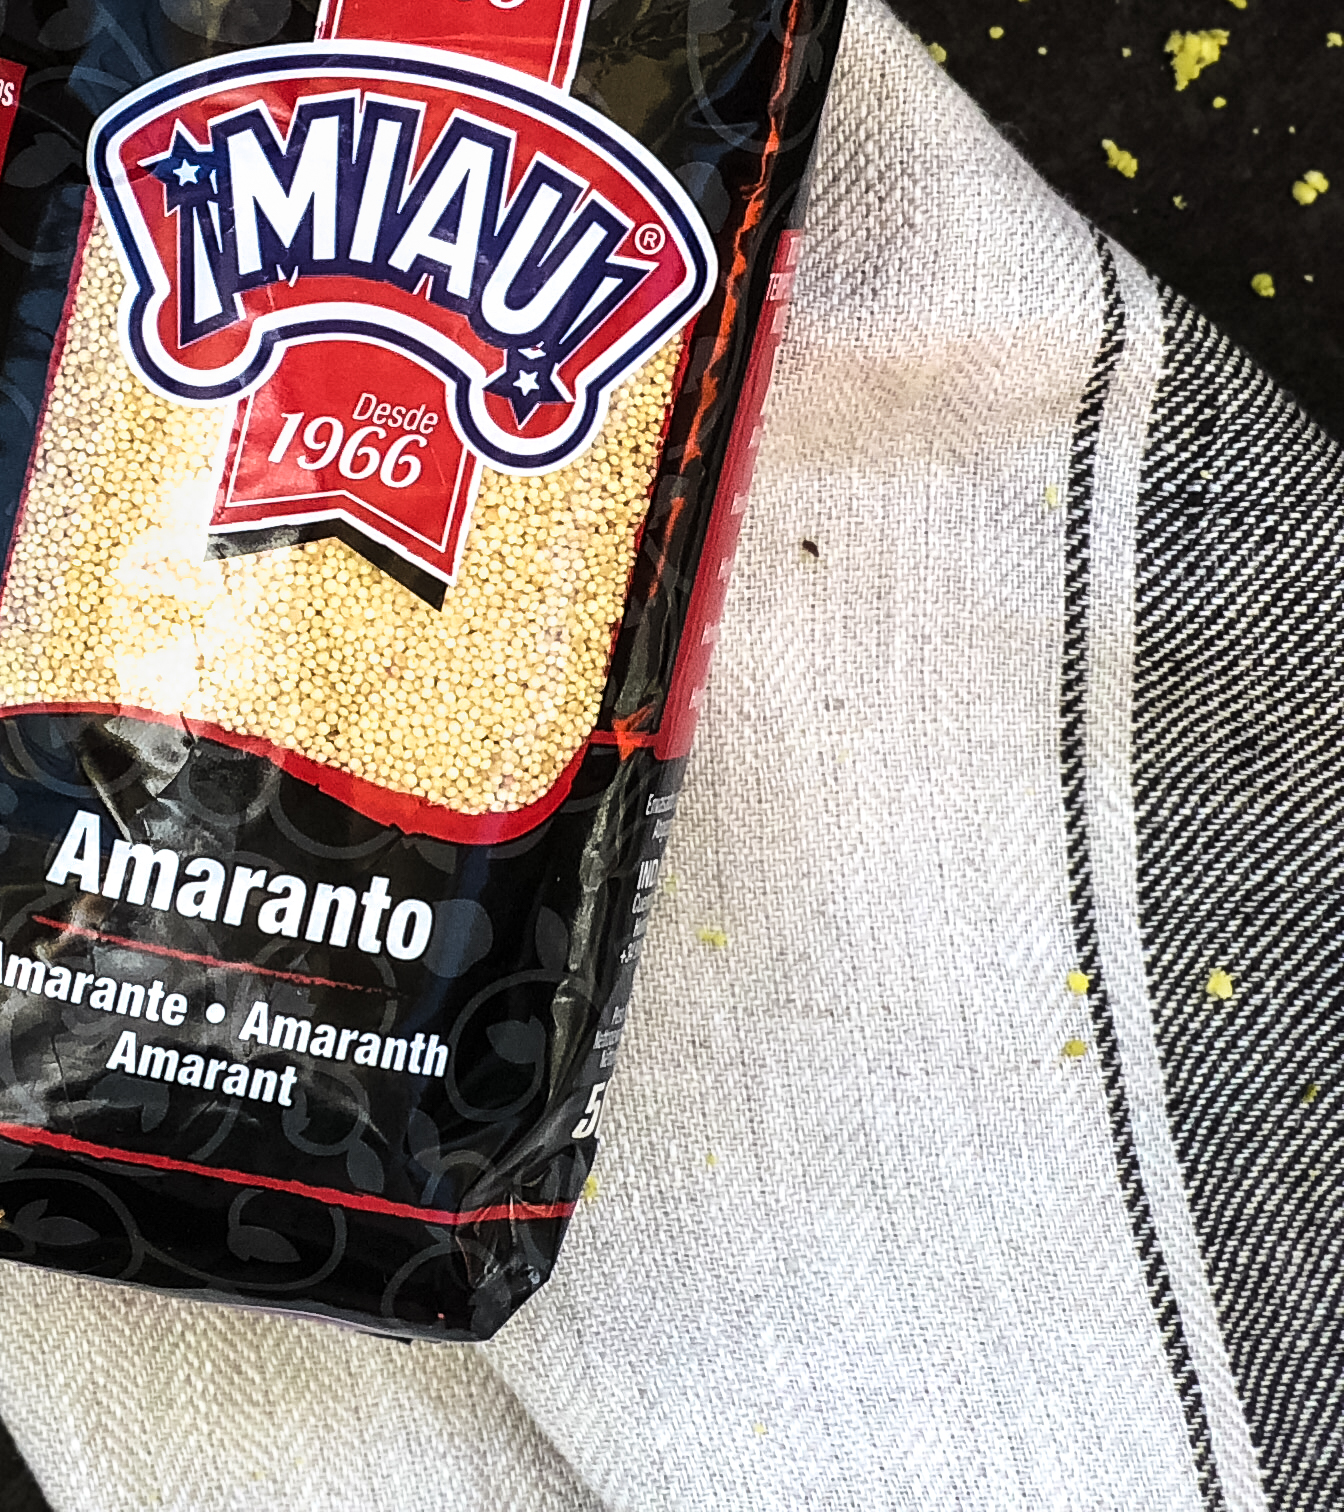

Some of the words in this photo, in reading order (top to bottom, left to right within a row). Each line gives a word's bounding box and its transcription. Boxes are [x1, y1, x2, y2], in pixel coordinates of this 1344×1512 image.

[267, 411, 428, 489] 1966
[352, 392, 439, 435] Desde
[45, 808, 434, 961] Amaranto
[105, 1029, 298, 1108] Amarant
[237, 999, 450, 1079] Amaranth
